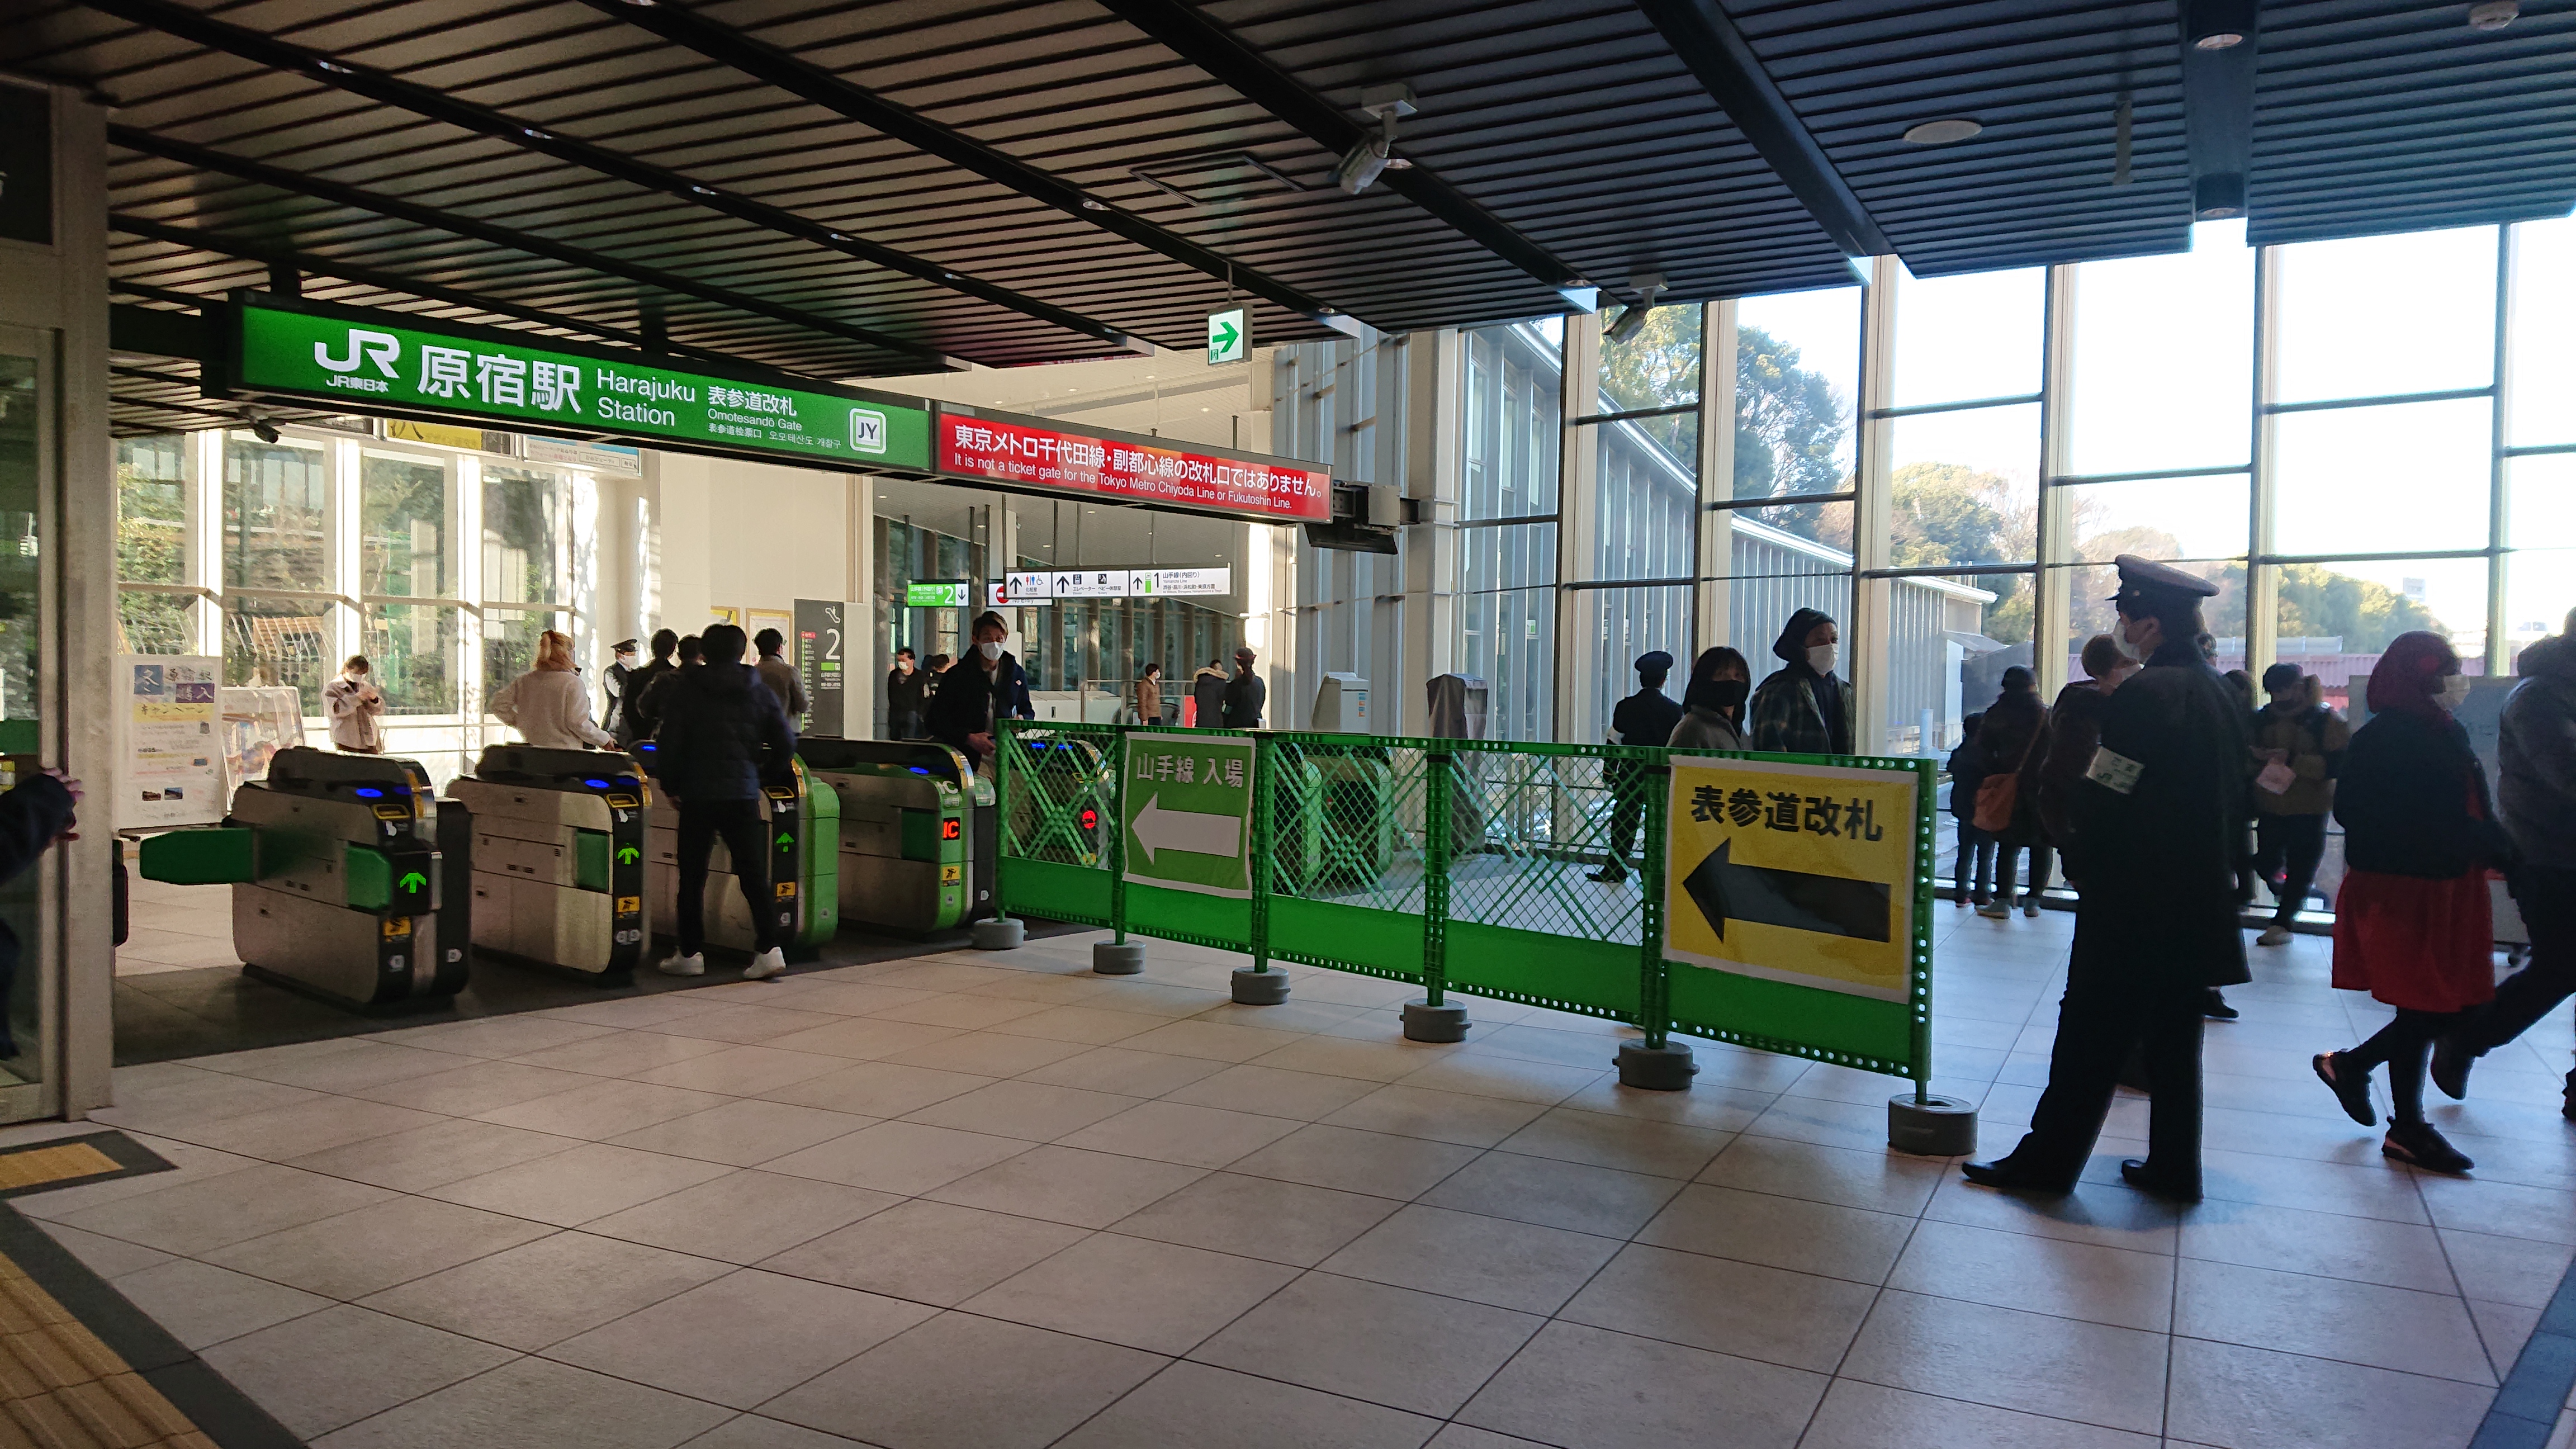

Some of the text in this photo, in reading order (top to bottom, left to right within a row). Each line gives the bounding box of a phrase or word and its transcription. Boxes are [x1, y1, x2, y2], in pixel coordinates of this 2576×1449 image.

[314, 328, 400, 378] JR
[326, 375, 389, 392] JR東日本
[416, 344, 581, 414] 原宿駅
[597, 368, 695, 402] Harajuku
[598, 396, 675, 427] Station
[708, 385, 797, 416] 表参道改札
[707, 408, 802, 432] Omotesandō Gate
[858, 422, 878, 440] JY
[955, 424, 1322, 498] 東京メトロ千代田線・副都心線の改札口ではありません。
[954, 452, 1292, 509] It is not a ticket gate for the Tokyo Metro Chiyoda Line or Fukutoshin Line.
[944, 586, 954, 604] 2
[1154, 572, 1159, 588] 1
[826, 628, 841, 660] 2
[1136, 752, 1244, 788] 山手線 入場
[1690, 785, 1883, 842] 表参道改札
[943, 821, 959, 838] IC
